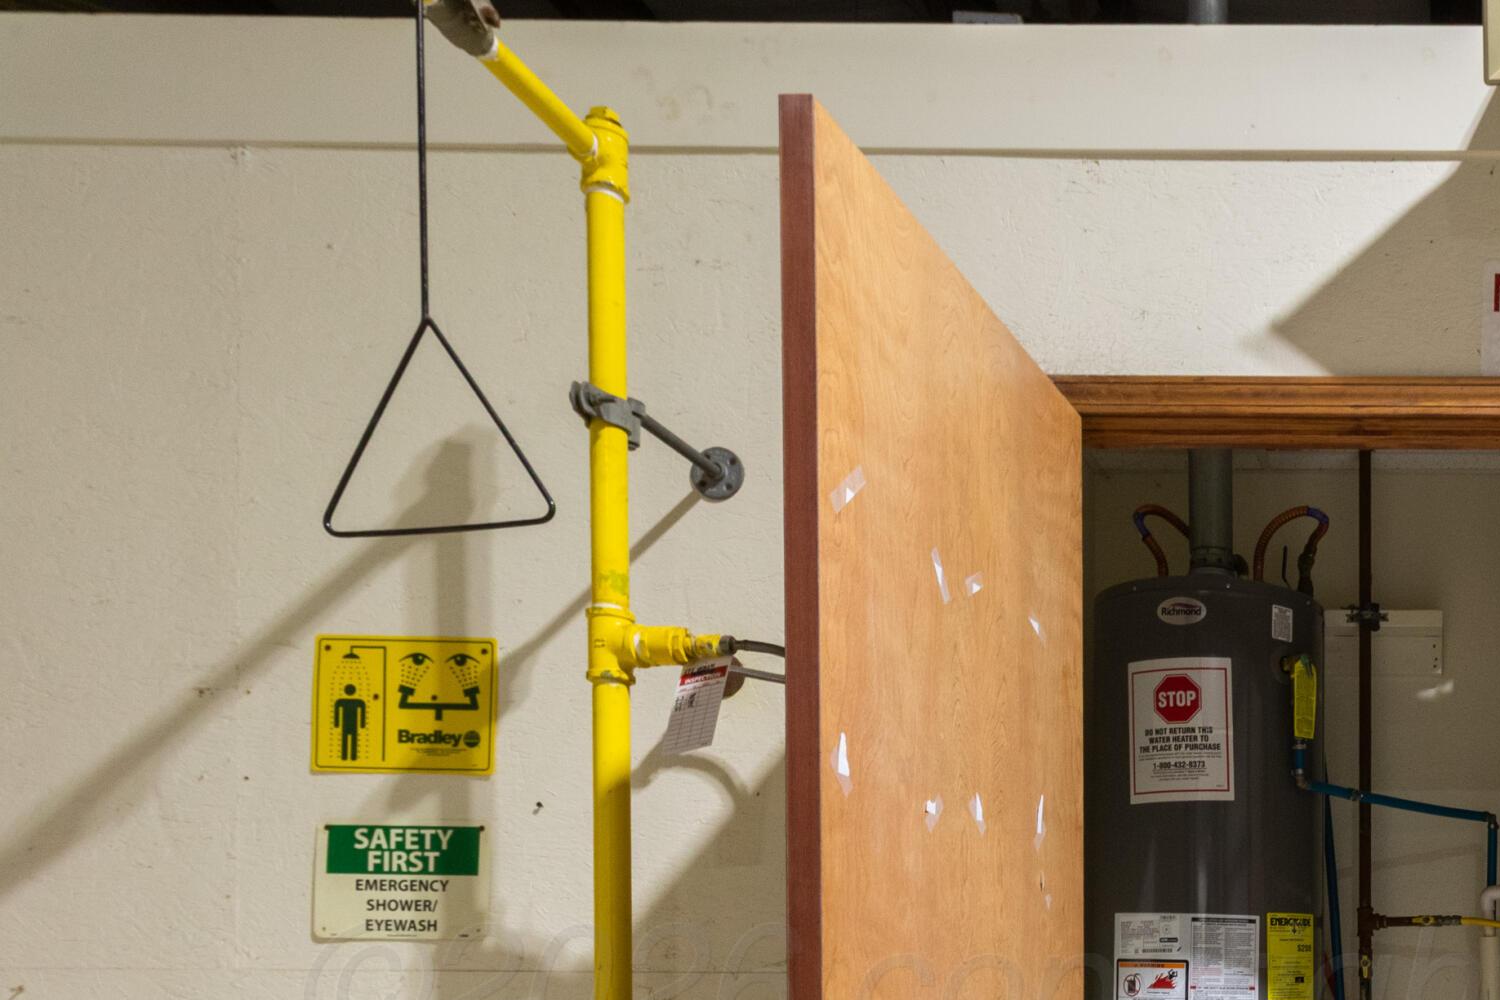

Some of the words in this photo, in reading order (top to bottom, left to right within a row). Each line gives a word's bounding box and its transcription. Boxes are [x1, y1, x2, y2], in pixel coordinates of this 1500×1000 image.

[1161, 606, 1202, 617] Richmond
[1158, 689, 1197, 708] STOP
[1198, 726, 1213, 734] THIS
[397, 729, 463, 747] Bradley
[1149, 736, 1170, 744] WATER
[1172, 735, 1198, 743] HEATER
[1139, 746, 1150, 754] THE
[1152, 745, 1172, 753] PLACE
[1184, 743, 1221, 751] PURCHASE
[353, 828, 454, 850] SAFETY
[367, 850, 440, 872] FIRST
[355, 879, 449, 892] EMERGENCY
[366, 899, 438, 912] SHOWER/
[365, 919, 438, 932] EYEWASH
